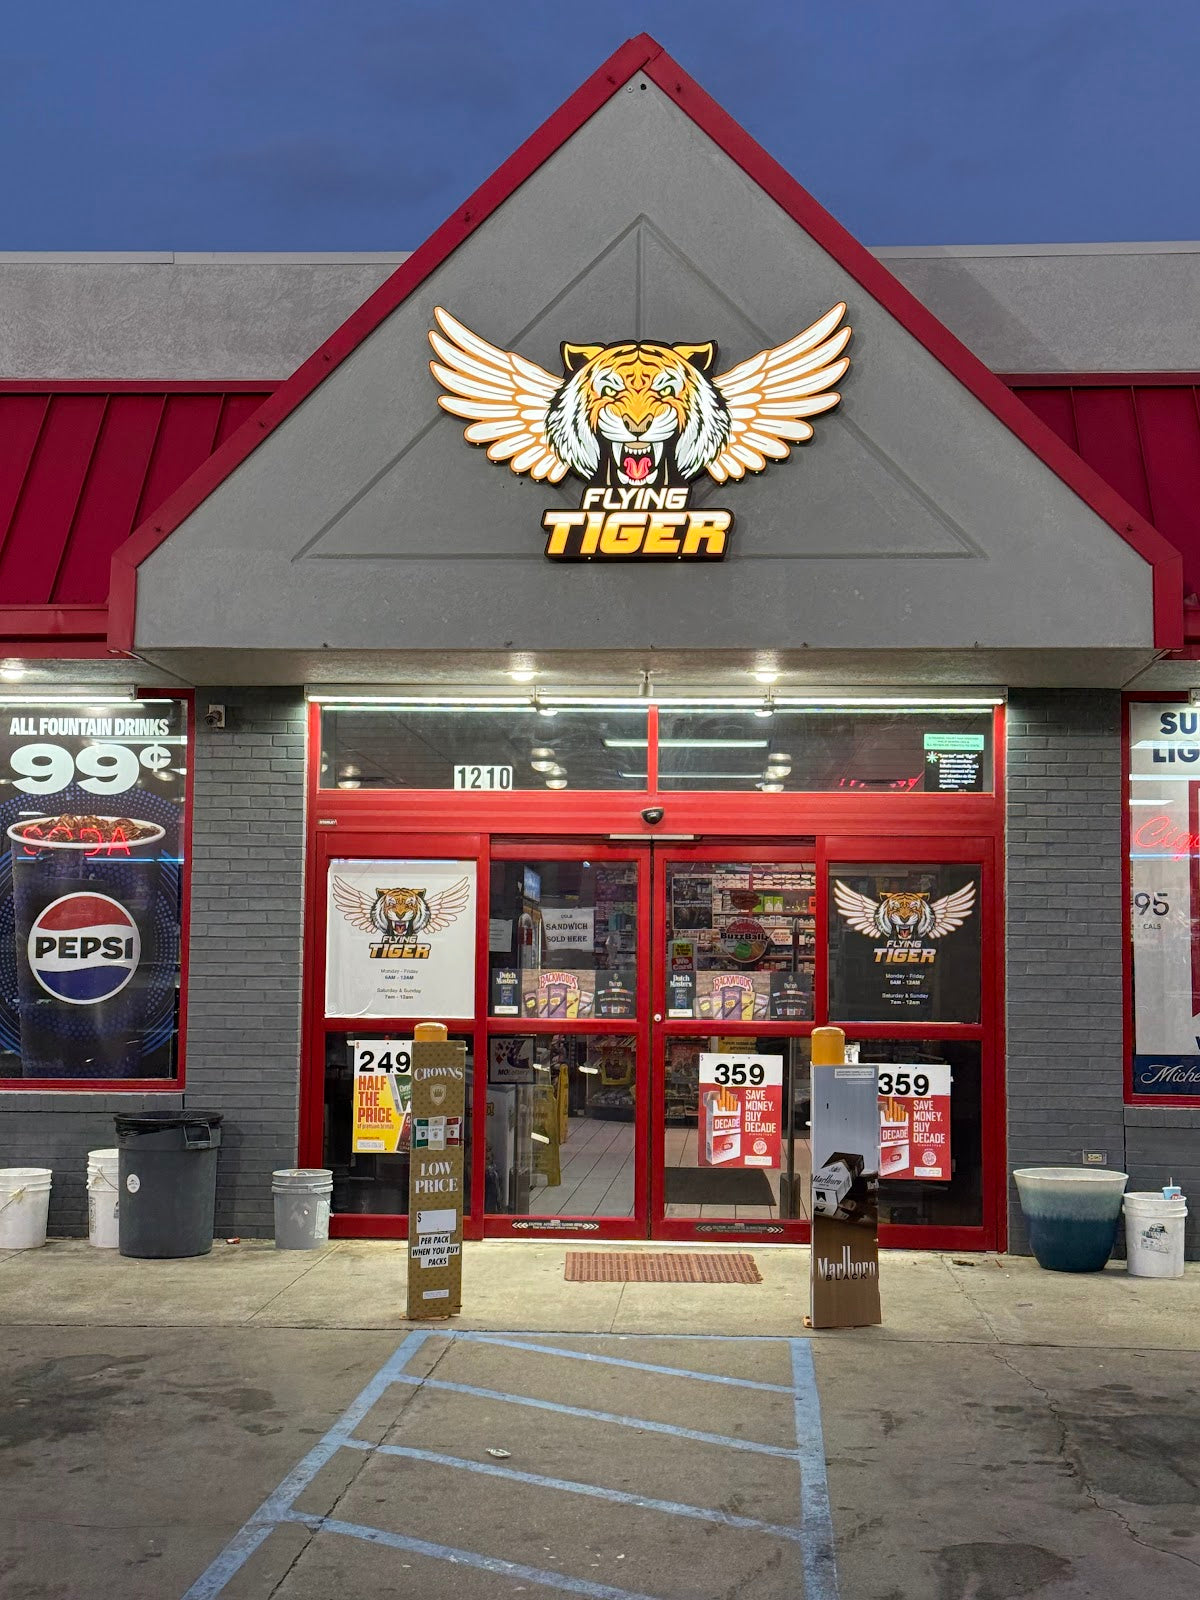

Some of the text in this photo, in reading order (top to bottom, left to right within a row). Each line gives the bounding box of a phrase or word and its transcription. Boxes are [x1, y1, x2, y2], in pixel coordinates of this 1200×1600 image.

[583, 488, 689, 510] FLYING
[544, 511, 731, 554] TIGER
[9, 717, 169, 737] ALL FOUNTAIN DRINKS
[1160, 712, 1198, 735] SU
[457, 767, 510, 790] 1210
[1134, 892, 1170, 916] 95
[545, 922, 588, 931] SANDWICH
[382, 935, 417, 944] FLYING
[886, 940, 922, 949] FLYING
[35, 936, 134, 960] PEPSI
[369, 943, 432, 958] TIGER
[873, 948, 937, 963] TIGER
[495, 977, 519, 985] Masters
[499, 971, 517, 979] Dutch
[539, 971, 579, 991] BACKWOODS
[672, 974, 690, 982] Dutch
[669, 980, 693, 988] Masters
[712, 974, 753, 993] BACKWOODS
[414, 1067, 463, 1081] CROWNS
[714, 1063, 765, 1086] 359
[357, 1075, 387, 1091] HALF
[879, 1073, 930, 1097] 359
[358, 1091, 380, 1106] THE
[745, 1089, 766, 1101] SAVE
[745, 1100, 775, 1112] MONEY.
[913, 1100, 934, 1111] SAVE
[357, 1107, 392, 1123] PRICE
[745, 1111, 762, 1122] BUY
[913, 1111, 943, 1122] MONEY.
[714, 1118, 740, 1130] DECADE
[745, 1121, 777, 1134] DECADE
[913, 1121, 930, 1133] BUY
[882, 1129, 909, 1141] DECADE
[913, 1132, 946, 1144] DECADE
[421, 1162, 454, 1177] LOW
[813, 1174, 843, 1186] Marlboro
[415, 1179, 458, 1194] PRICE
[420, 1235, 449, 1245] PER PACK
[412, 1246, 459, 1257] WHEN YOU BUY
[428, 1258, 447, 1266] PACKS
[817, 1245, 876, 1280] Marlboro
[826, 1272, 868, 1281] BLACK
